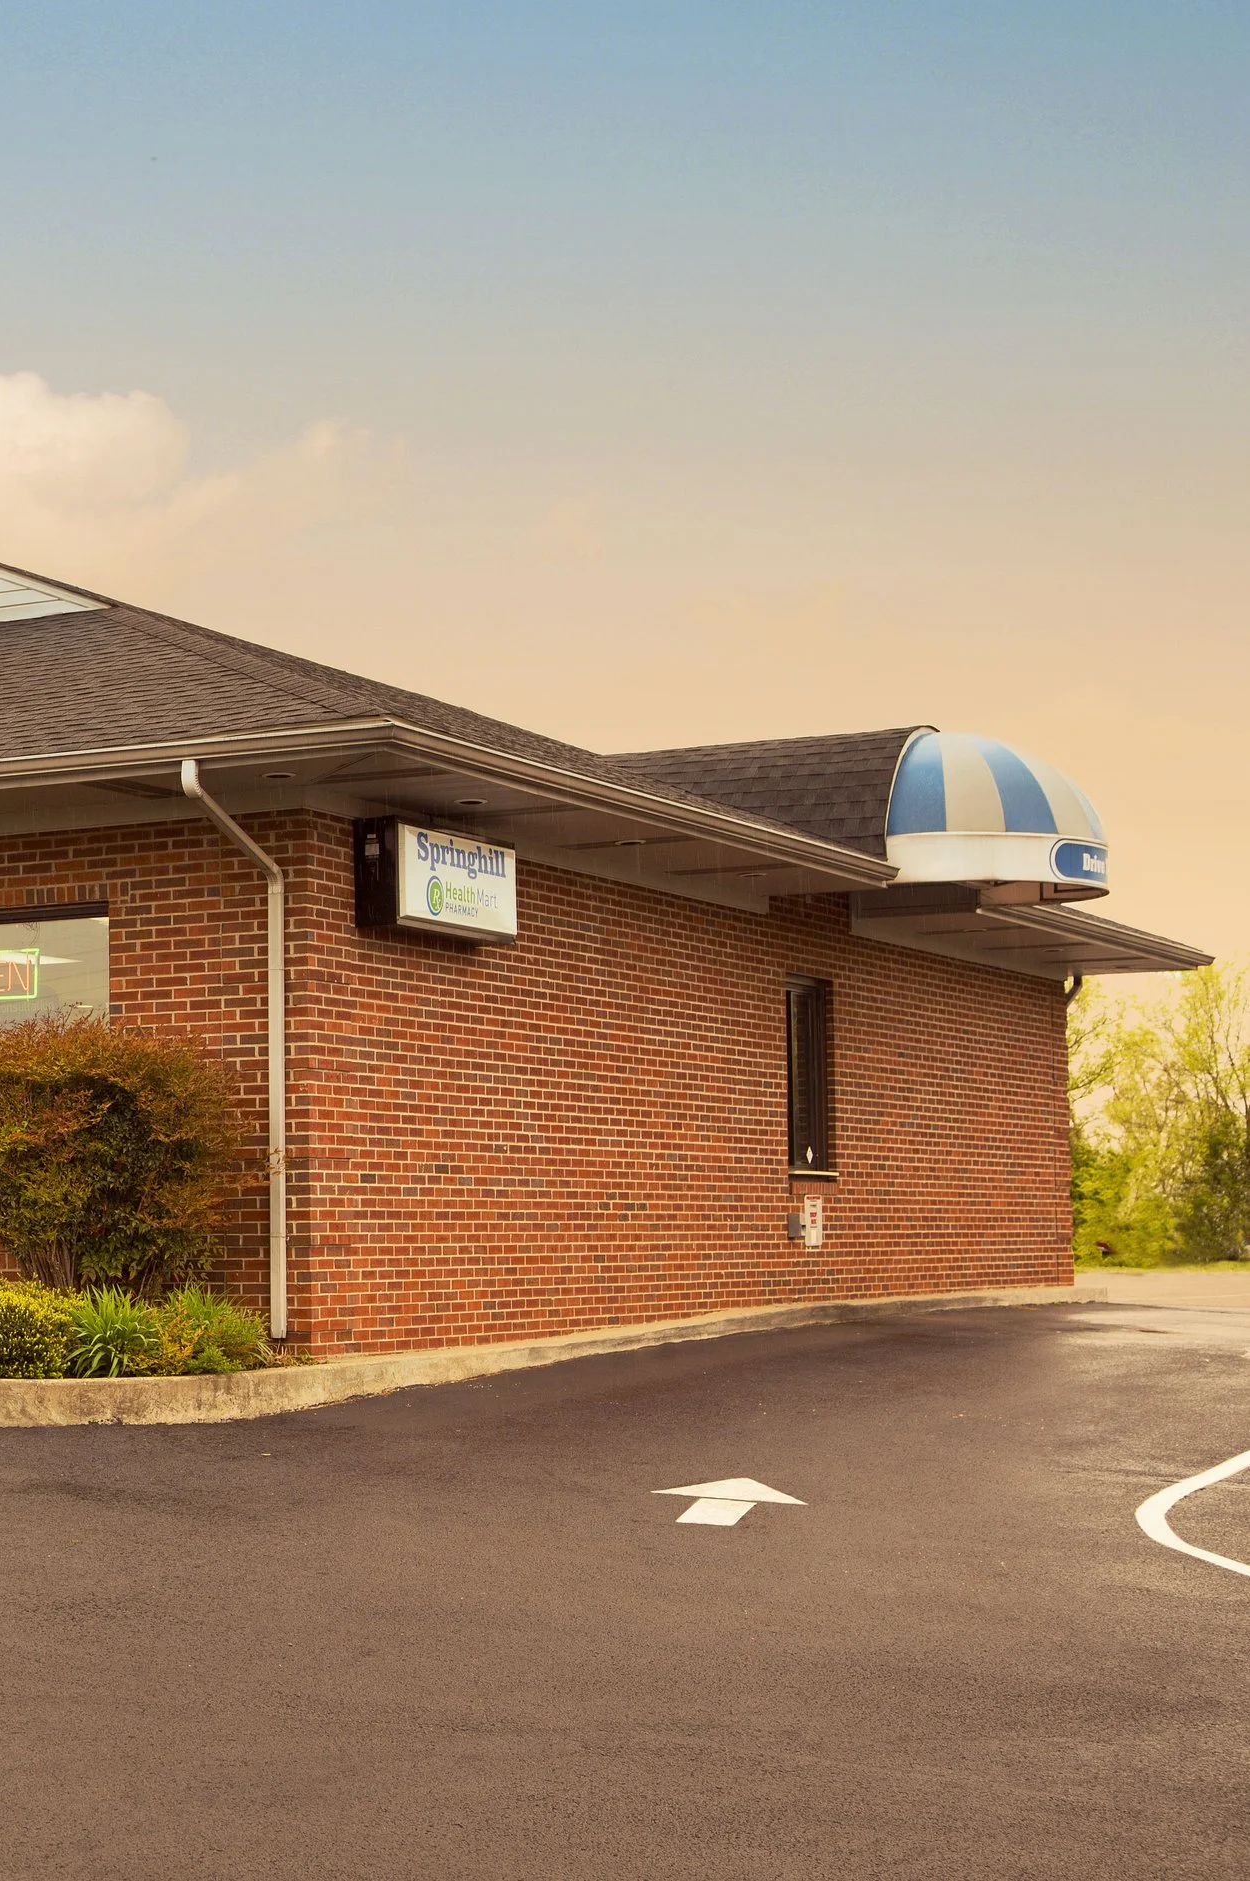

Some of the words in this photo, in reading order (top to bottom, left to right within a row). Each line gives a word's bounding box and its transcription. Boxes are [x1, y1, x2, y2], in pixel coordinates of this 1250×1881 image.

[417, 832, 506, 879] Springhill
[445, 881, 476, 905] Health
[476, 888, 497, 909] Mart
[445, 902, 478, 918] PHARMACY
